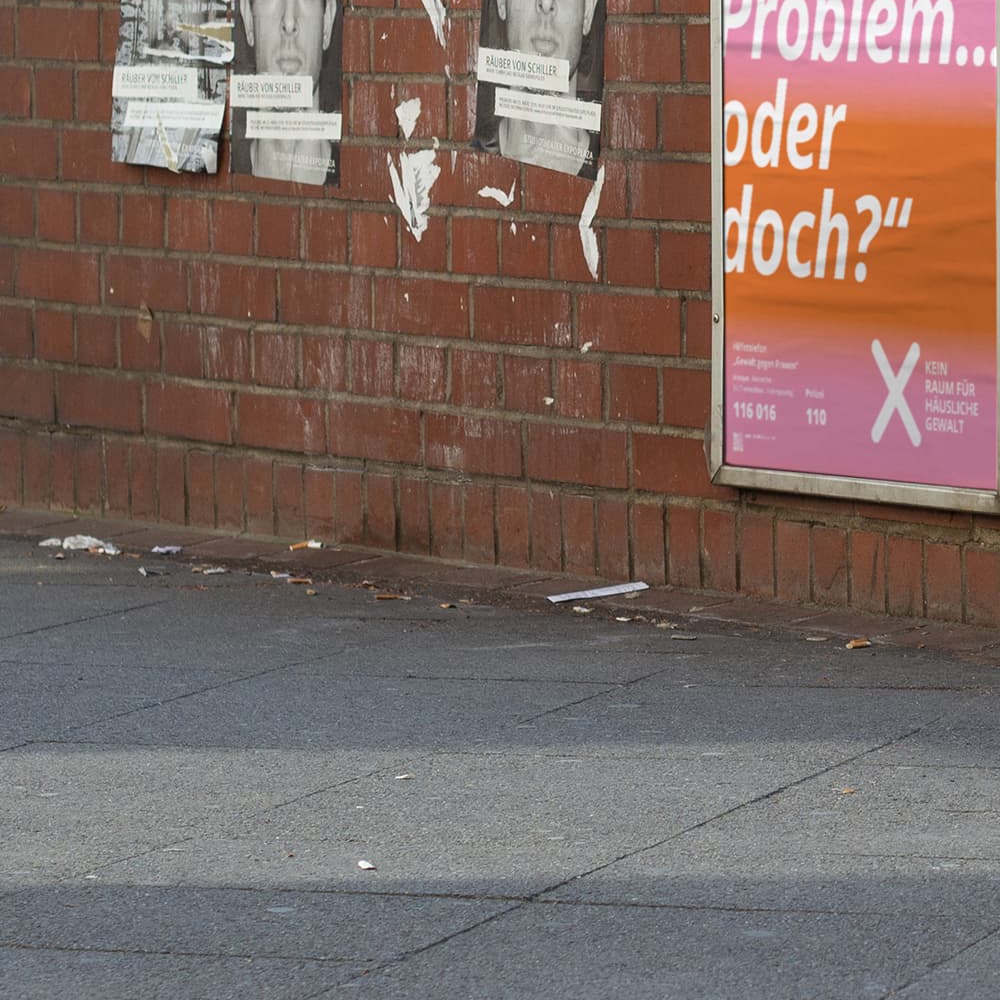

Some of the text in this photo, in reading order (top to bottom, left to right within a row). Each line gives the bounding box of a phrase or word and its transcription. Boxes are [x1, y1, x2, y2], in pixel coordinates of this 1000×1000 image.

[512, 59, 527, 72] VON
[527, 61, 558, 76] SCHILLER
[260, 82, 274, 93] VON
[275, 82, 302, 94] SCHILLER
[724, 78, 847, 170] oder
[925, 360, 948, 376] KEIN
[925, 379, 954, 396] RAUM
[733, 401, 777, 421] 116 016
[806, 408, 827, 426] 110
[925, 417, 965, 434] GEWALT
